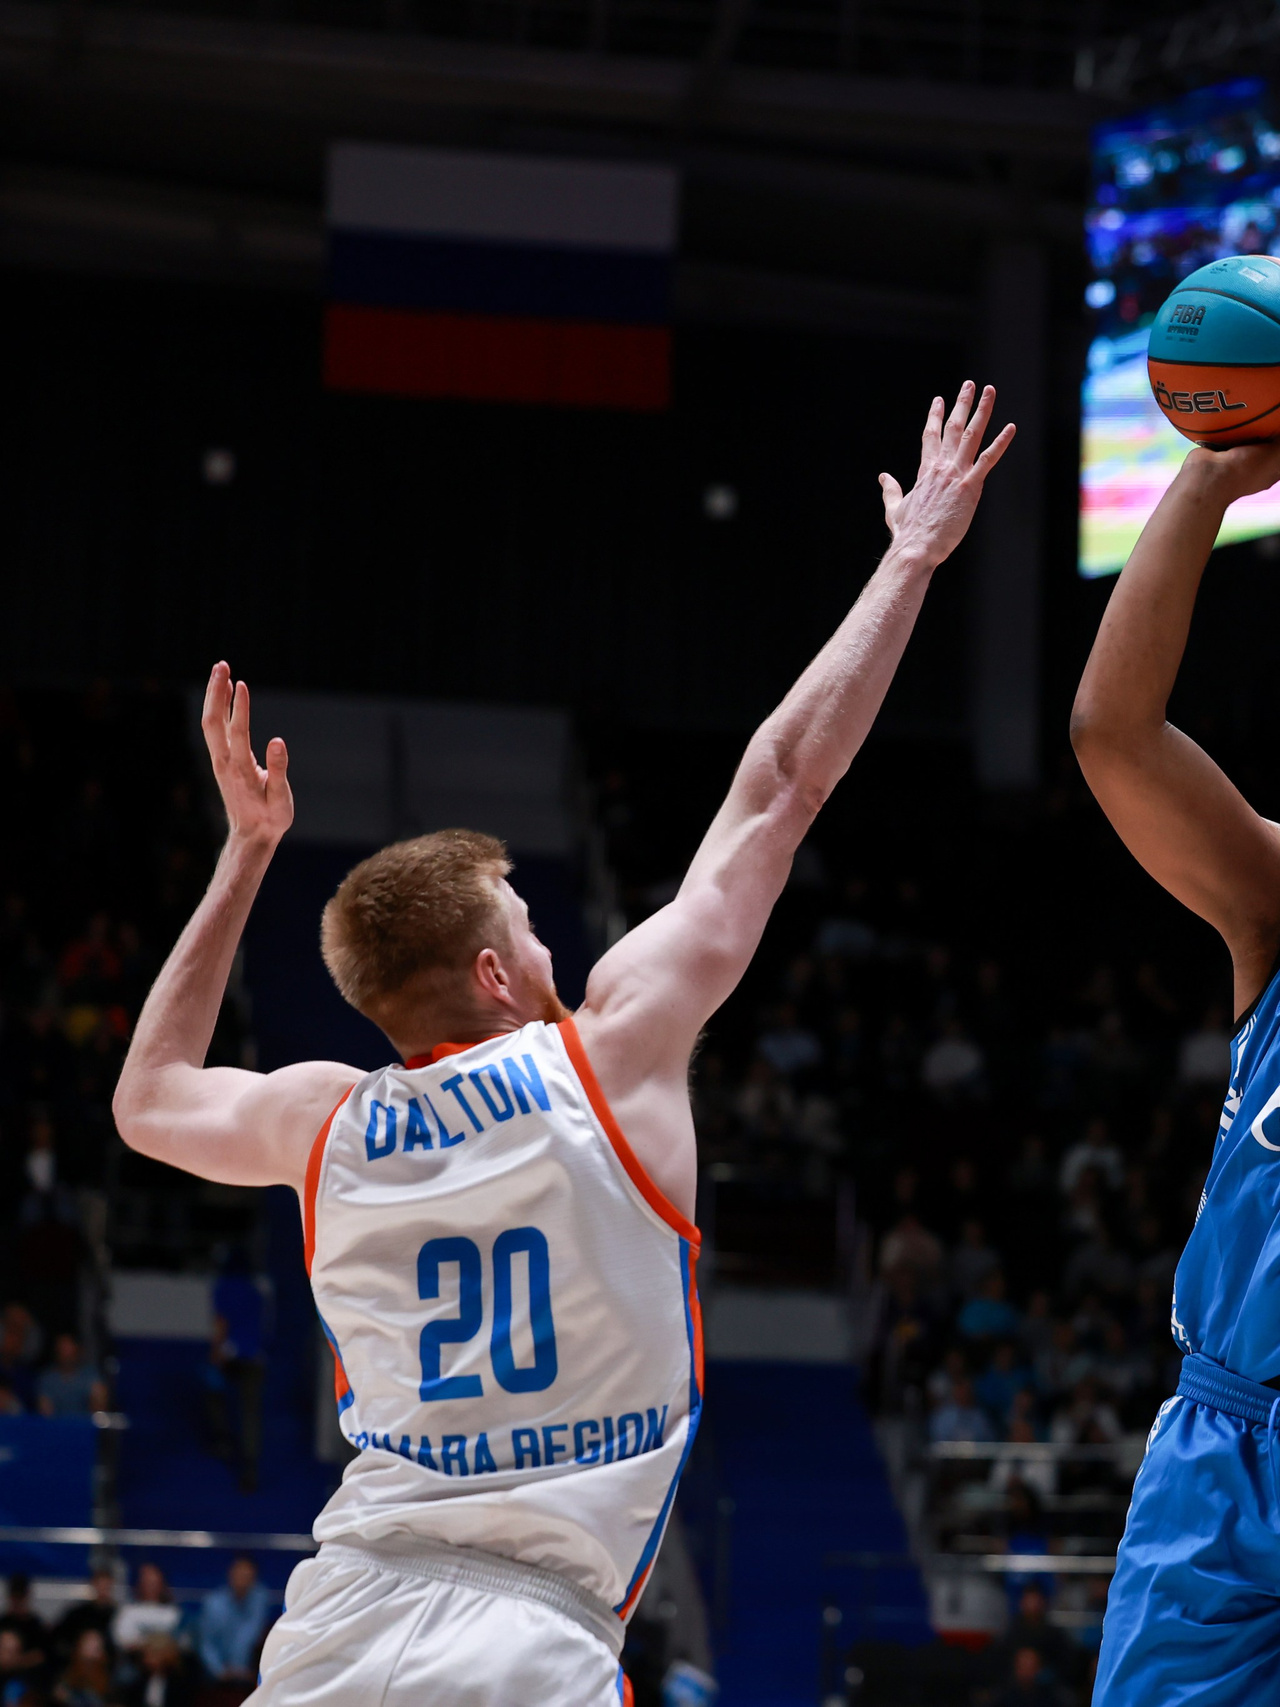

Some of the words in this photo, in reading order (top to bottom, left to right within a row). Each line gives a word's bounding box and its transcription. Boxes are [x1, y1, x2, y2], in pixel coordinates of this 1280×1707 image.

[1167, 325, 1199, 336] APPROVED
[1169, 303, 1206, 326] FIBA
[1153, 380, 1247, 414] ÖGEL
[365, 1053, 552, 1162] DALTON
[417, 1226, 559, 1402] 20
[511, 1403, 669, 1470] REGION
